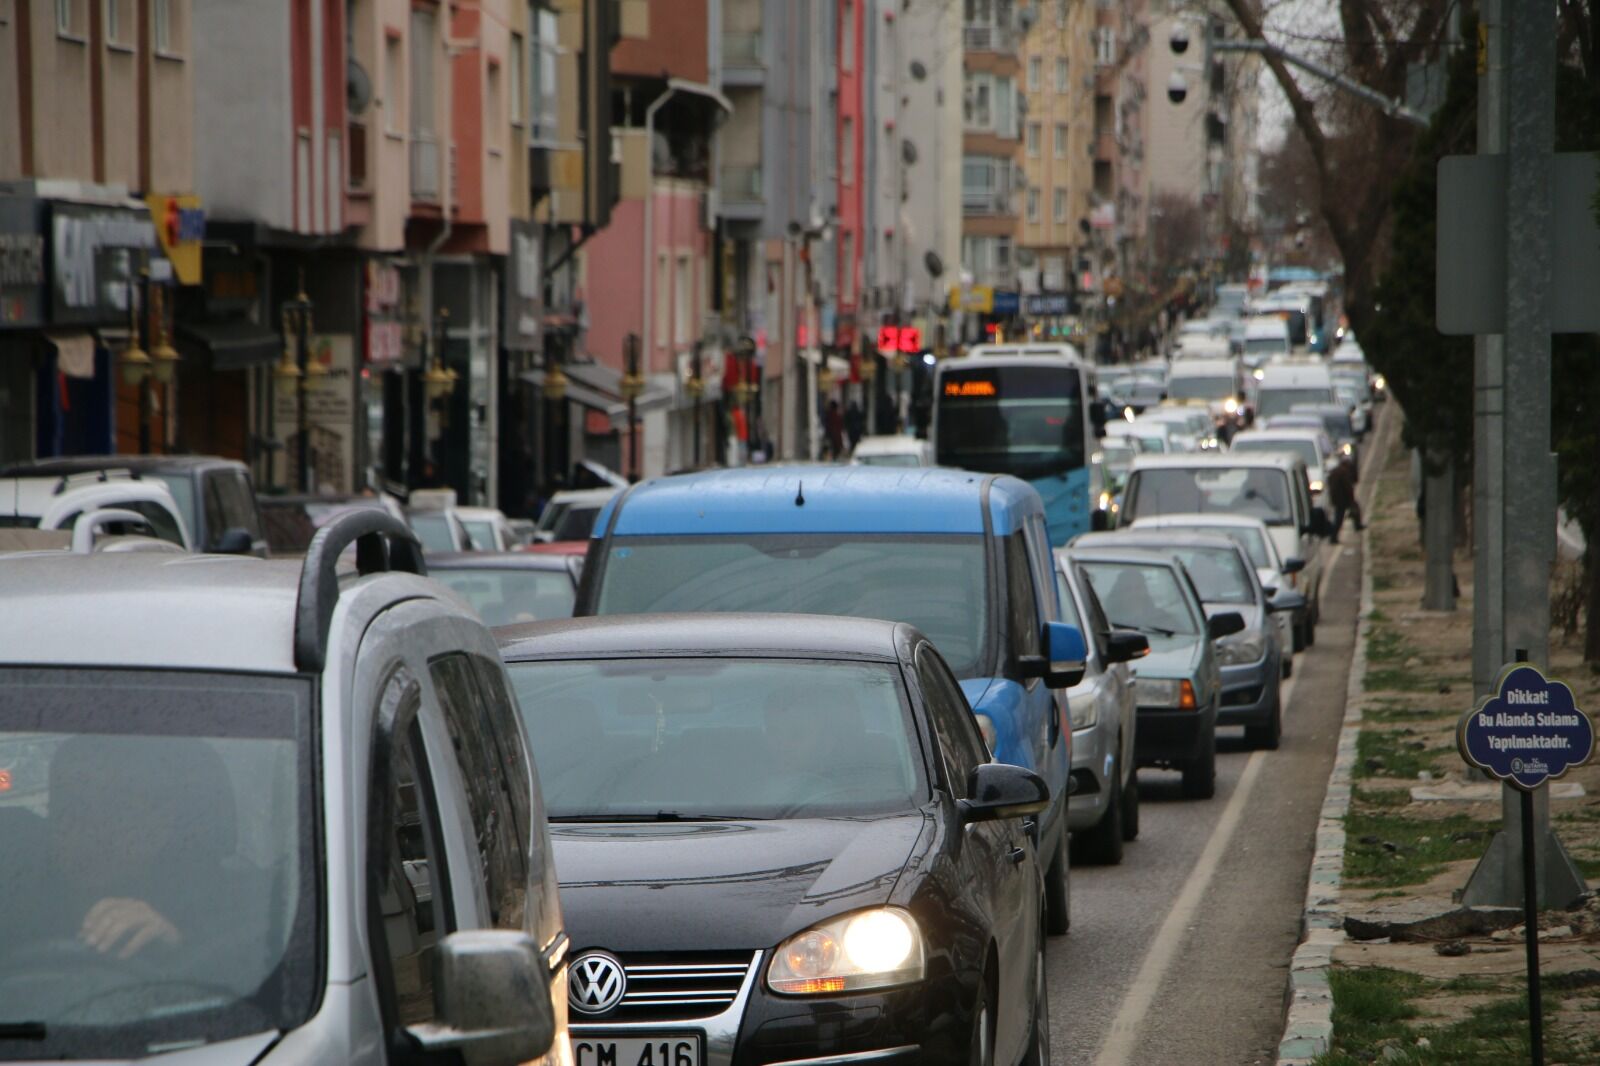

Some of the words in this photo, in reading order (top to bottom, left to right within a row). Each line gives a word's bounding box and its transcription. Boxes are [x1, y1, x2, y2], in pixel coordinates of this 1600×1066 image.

[1507, 689, 1549, 704] Dikkat!
[1479, 713, 1493, 727] Bu
[1496, 712, 1535, 727] Alanda
[1537, 712, 1579, 727] Sulama
[1488, 734, 1571, 752] Yapılmaktadır.
[576, 1042, 616, 1066] CM
[637, 1042, 692, 1066] 416
